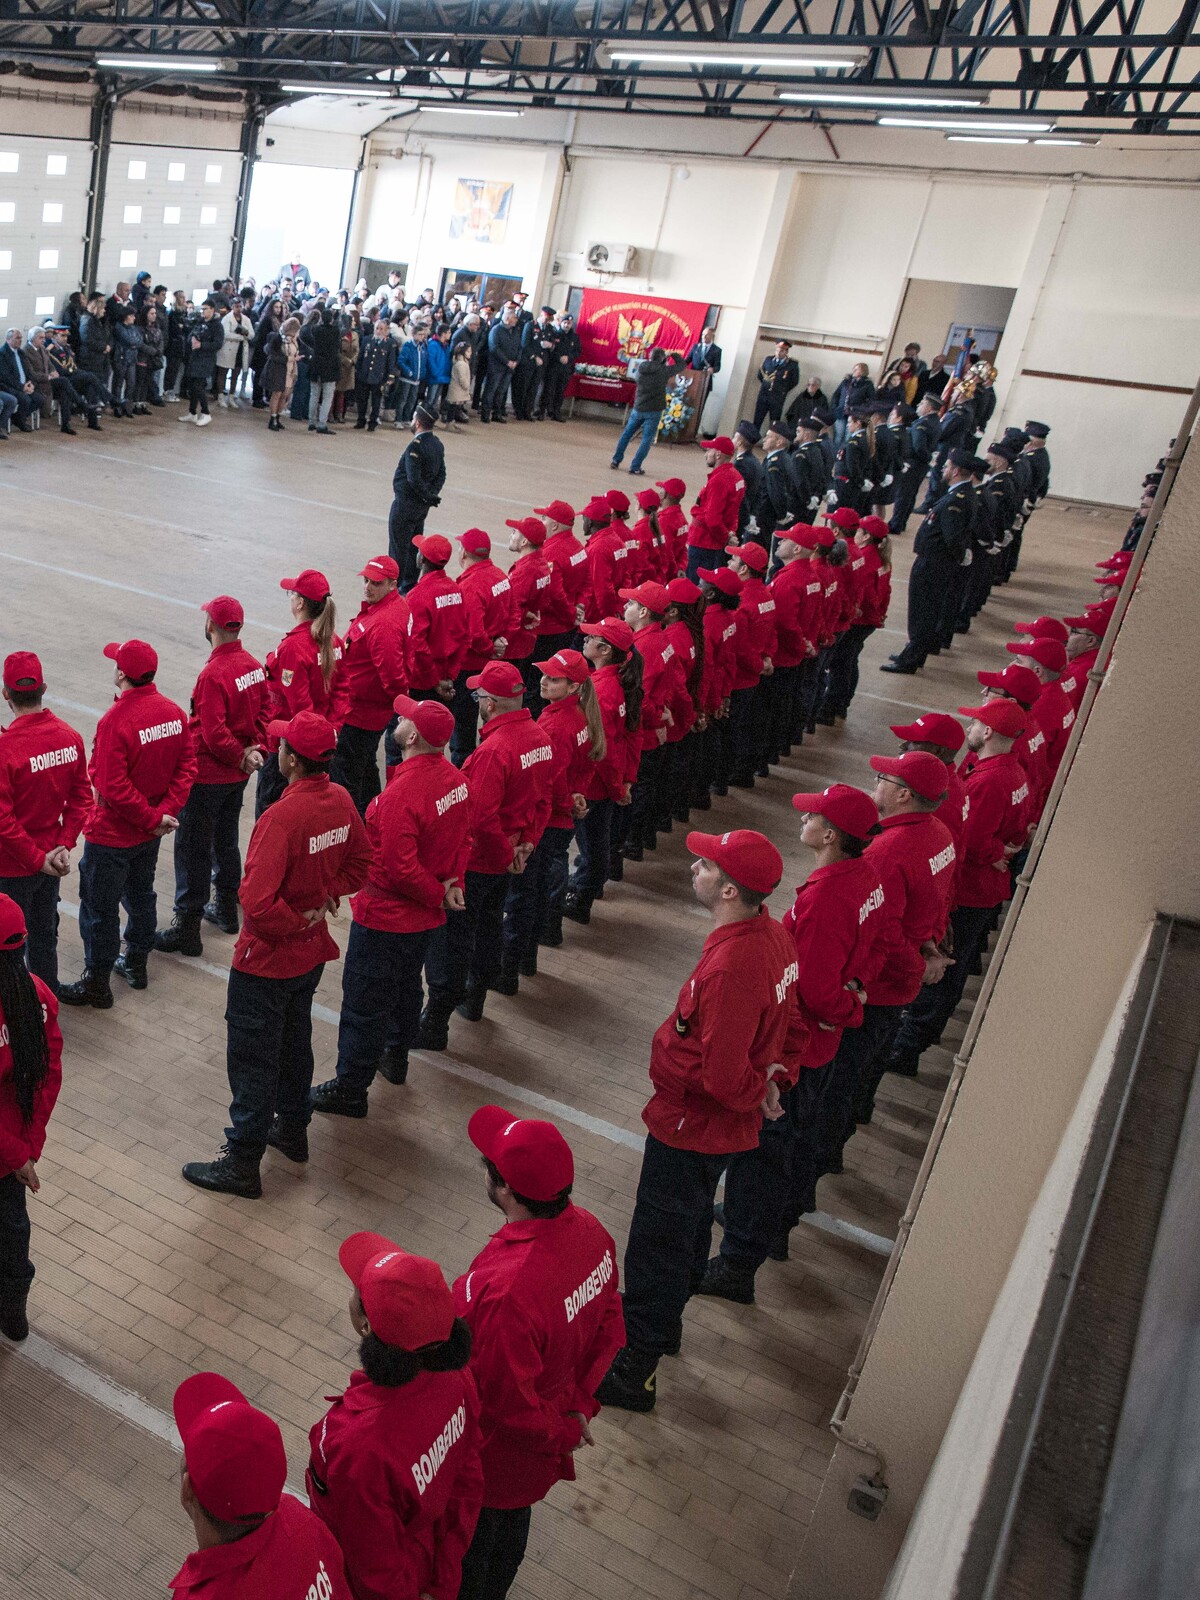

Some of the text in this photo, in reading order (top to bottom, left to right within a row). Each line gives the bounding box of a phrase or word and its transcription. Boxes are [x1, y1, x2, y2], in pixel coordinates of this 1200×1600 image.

[139, 719, 183, 745] BOMBEIROS
[30, 745, 78, 773] BOMBEIROS
[563, 1249, 613, 1323] BOMBEIROS
[411, 1398, 466, 1496] BOMBEIRO
